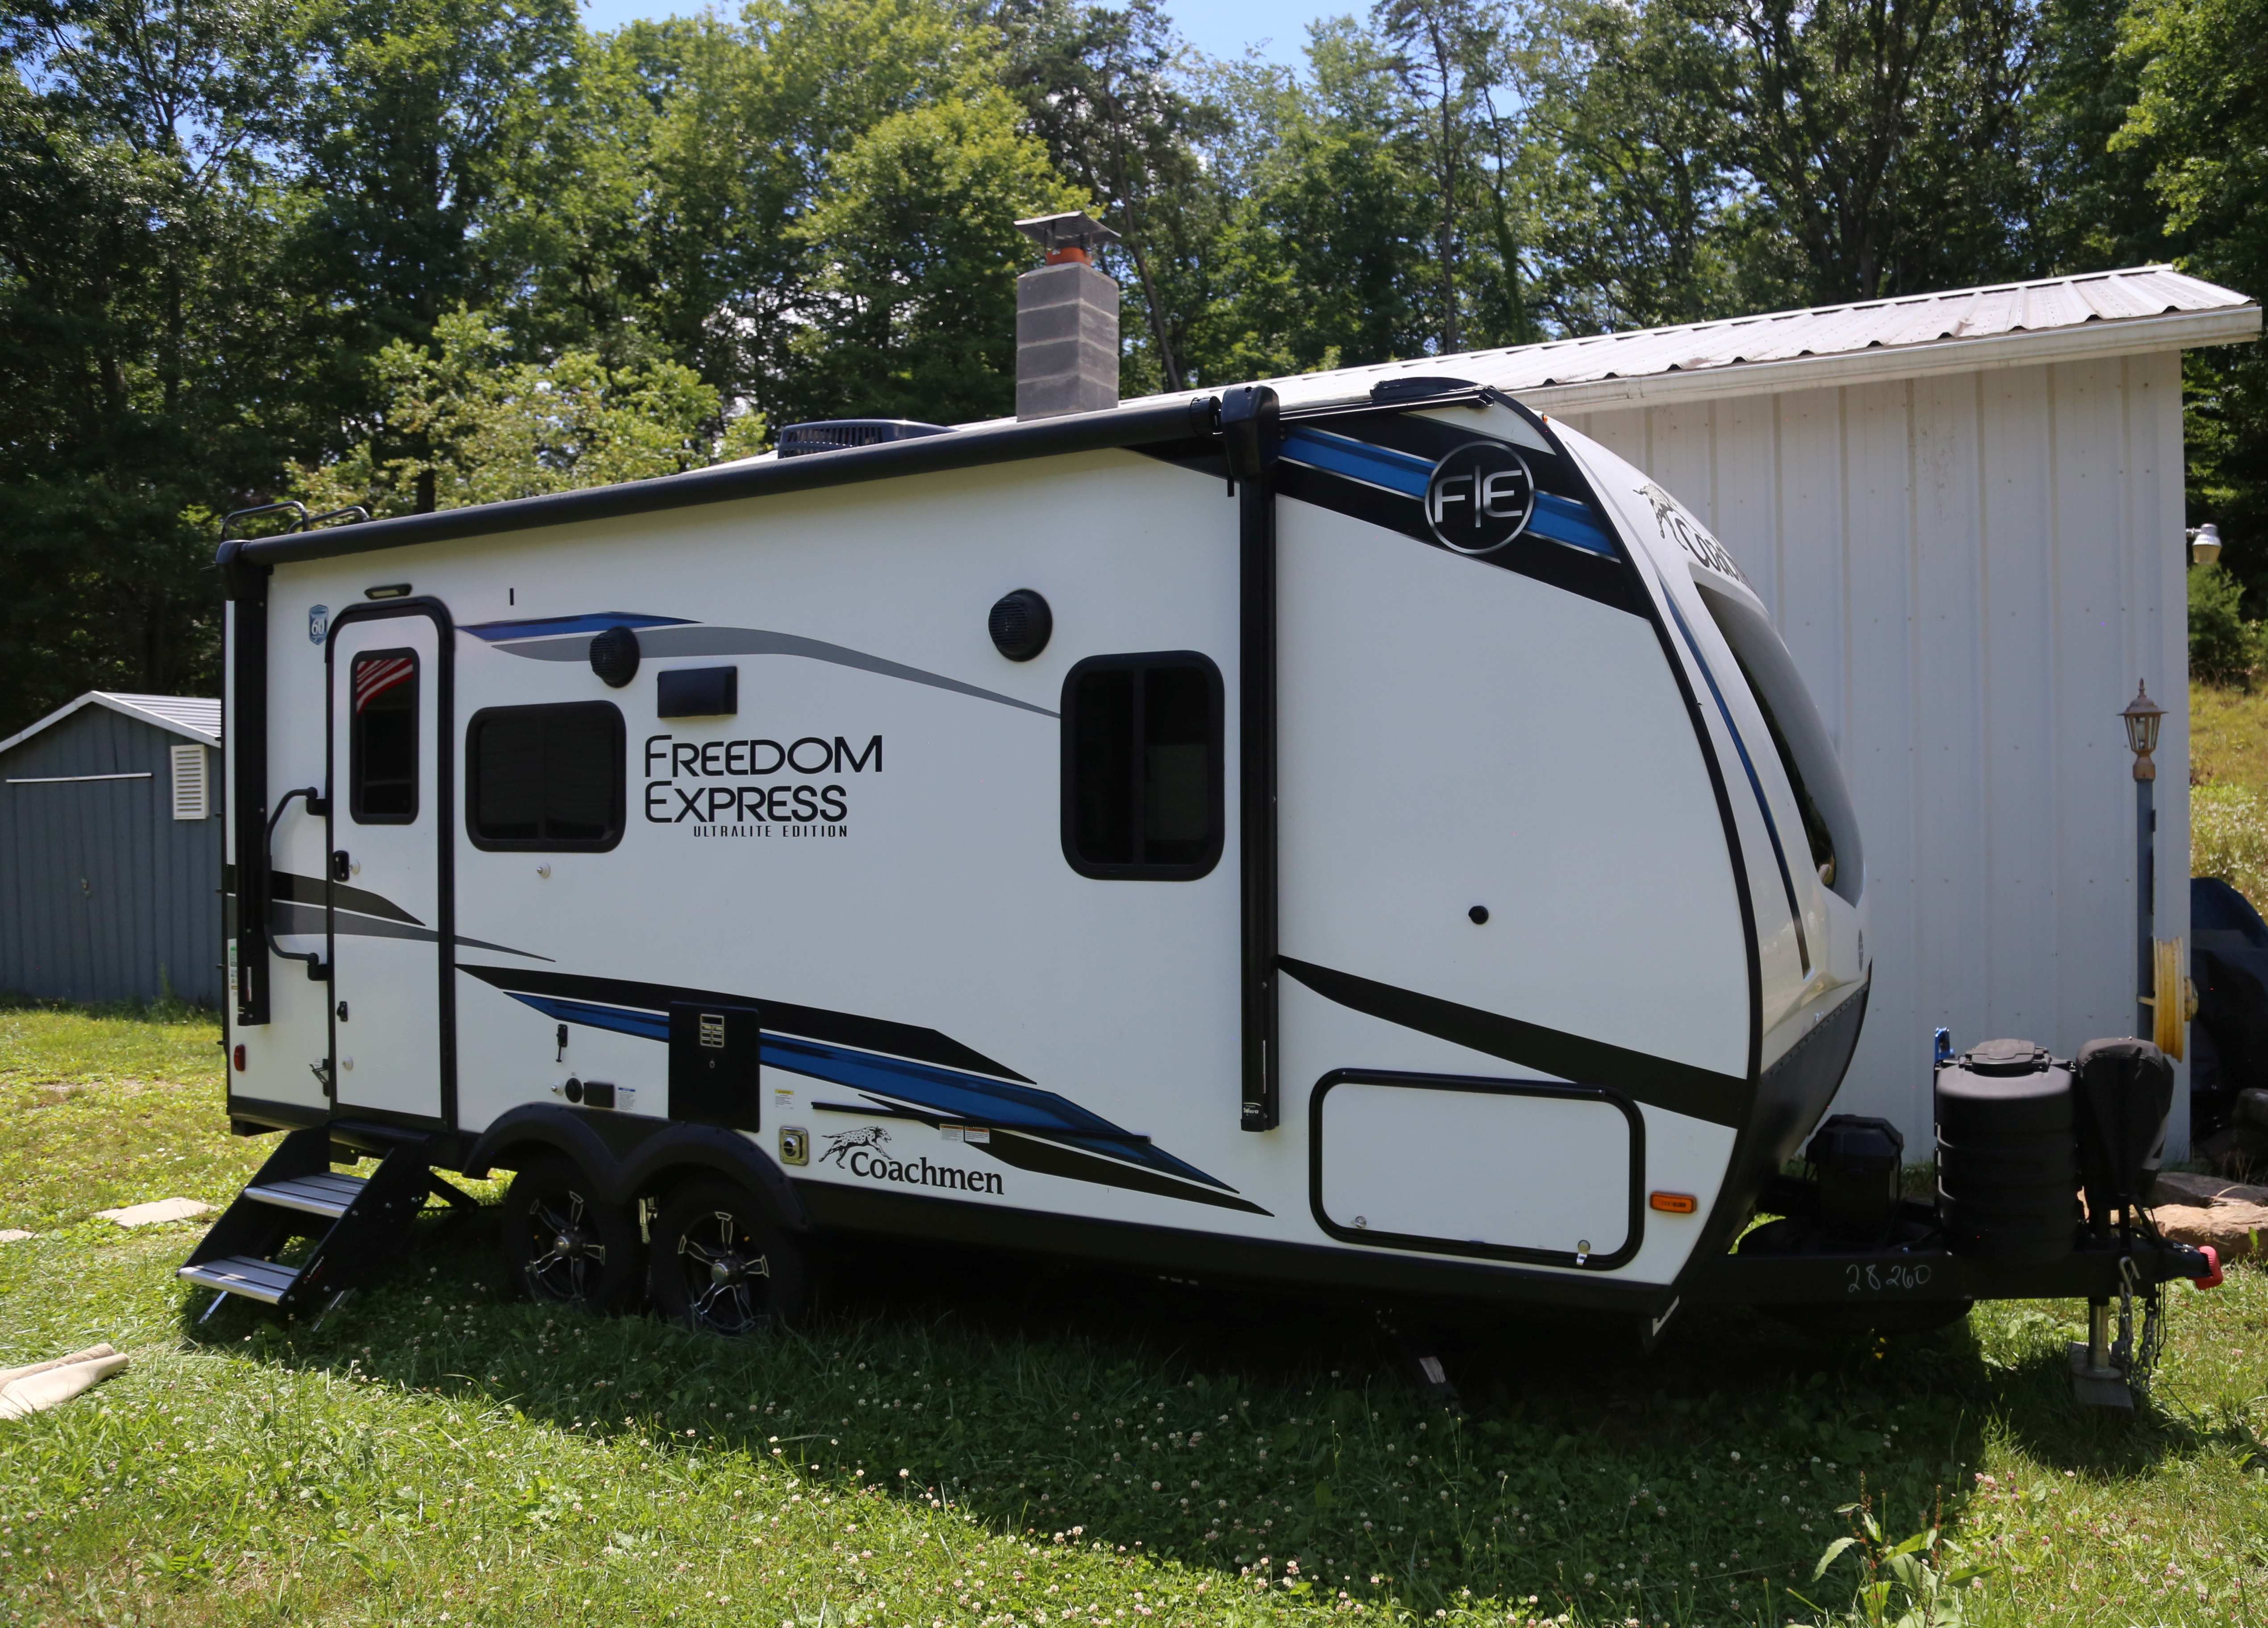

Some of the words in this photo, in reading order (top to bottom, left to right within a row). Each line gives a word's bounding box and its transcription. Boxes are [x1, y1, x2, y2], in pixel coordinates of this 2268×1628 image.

[645, 735, 882, 777] FREEDOM
[645, 781, 847, 823] EXPRESS
[693, 826, 771, 838] ULTRALITE
[782, 825, 847, 837] EDITION
[850, 1151, 1004, 1195] Coachmen
